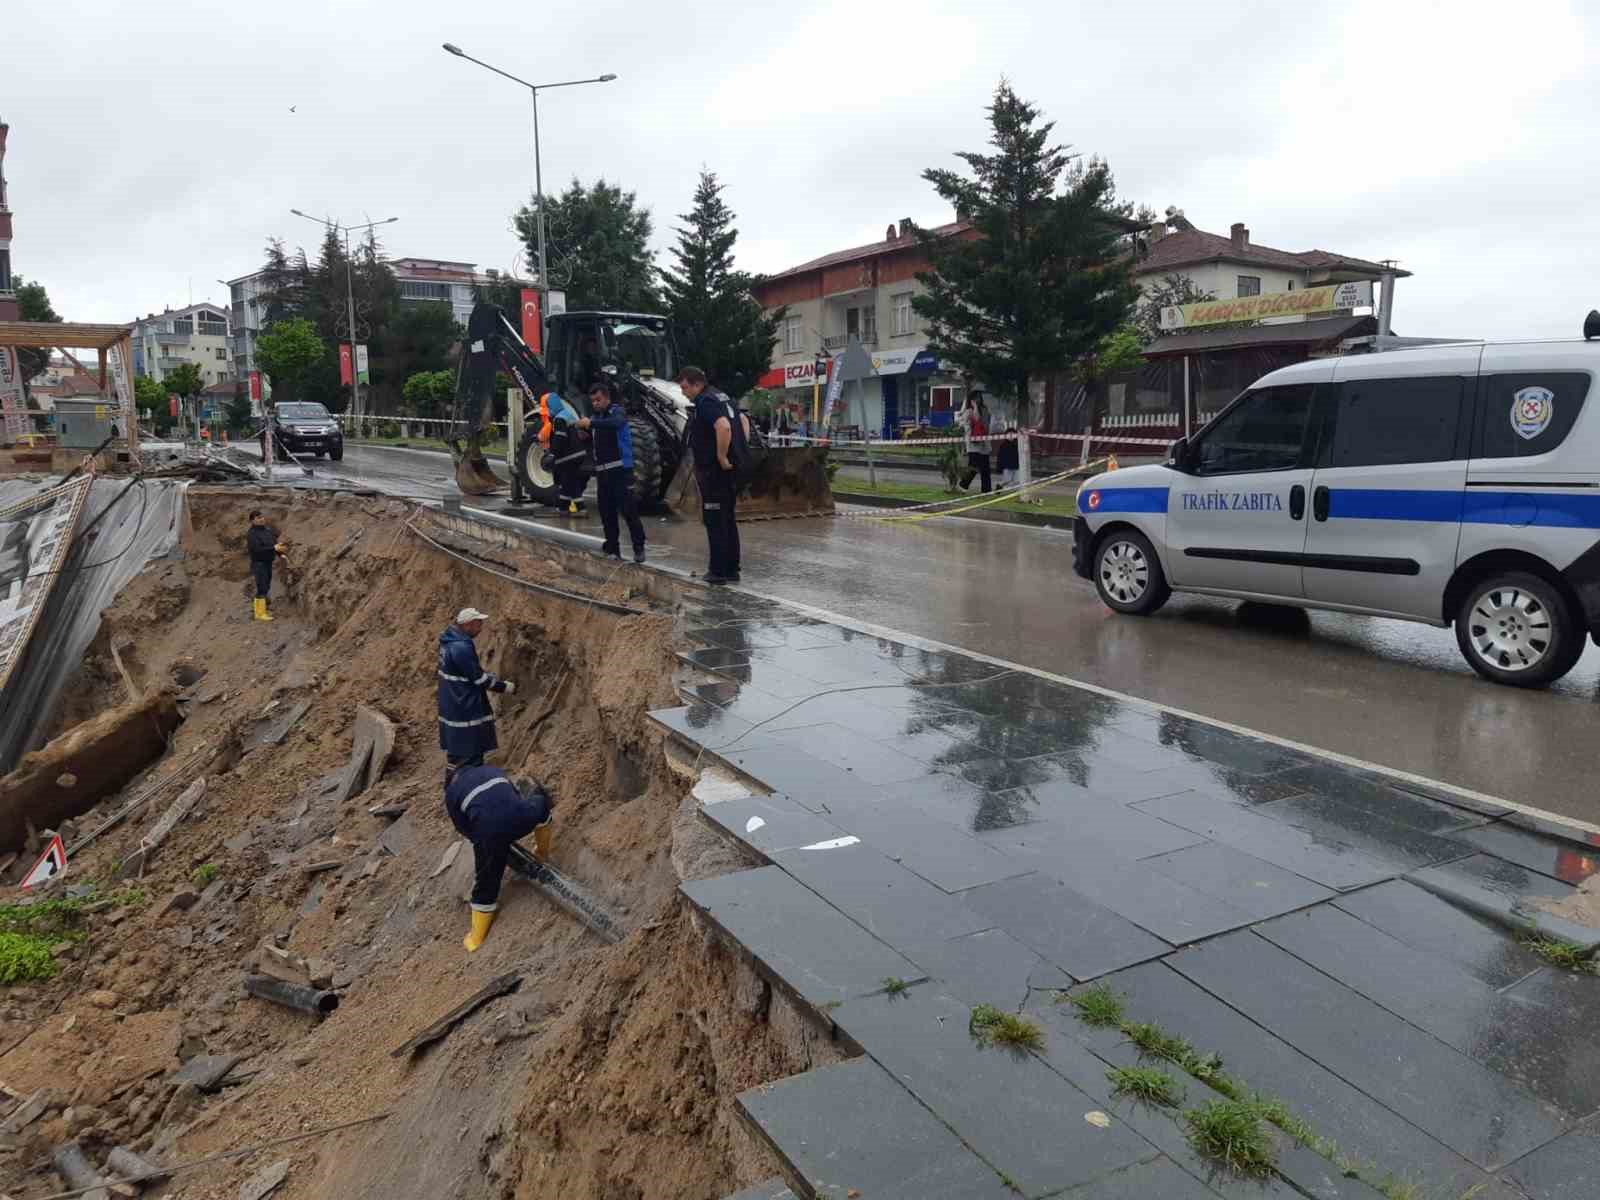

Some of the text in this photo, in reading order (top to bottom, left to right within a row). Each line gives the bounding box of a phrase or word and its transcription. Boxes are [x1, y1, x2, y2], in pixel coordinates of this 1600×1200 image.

[787, 364, 818, 379] ECZAN
[1182, 489, 1282, 511] TRAFİK ZABITA
